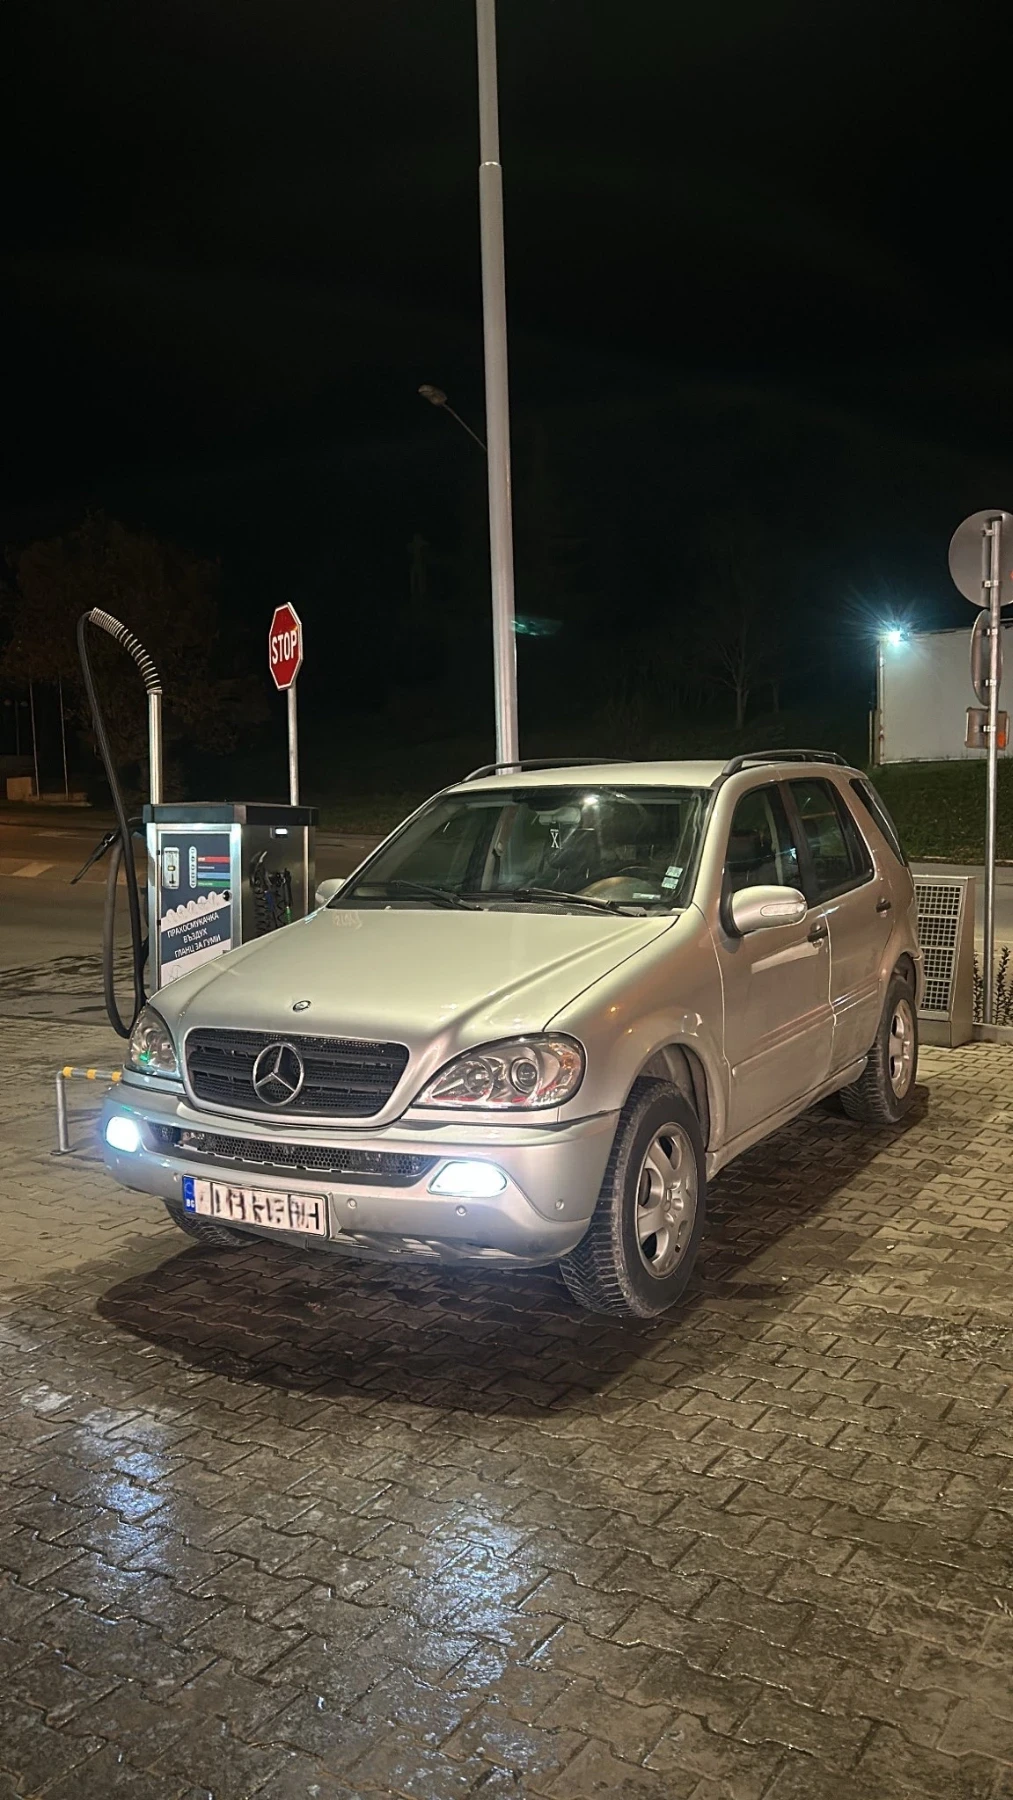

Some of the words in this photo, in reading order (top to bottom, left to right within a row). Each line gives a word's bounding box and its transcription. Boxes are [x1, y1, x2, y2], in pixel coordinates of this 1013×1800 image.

[271, 630, 297, 664] STOP
[167, 912, 219, 938] ПРАХОСМУКАЧКА
[183, 928, 208, 944] ВЪЗДУХ
[174, 944, 195, 958] ГЛАНЦ
[195, 942, 203, 950] ЗА
[203, 934, 221, 947] ГУМИ
[186, 1198, 195, 1208] BG
